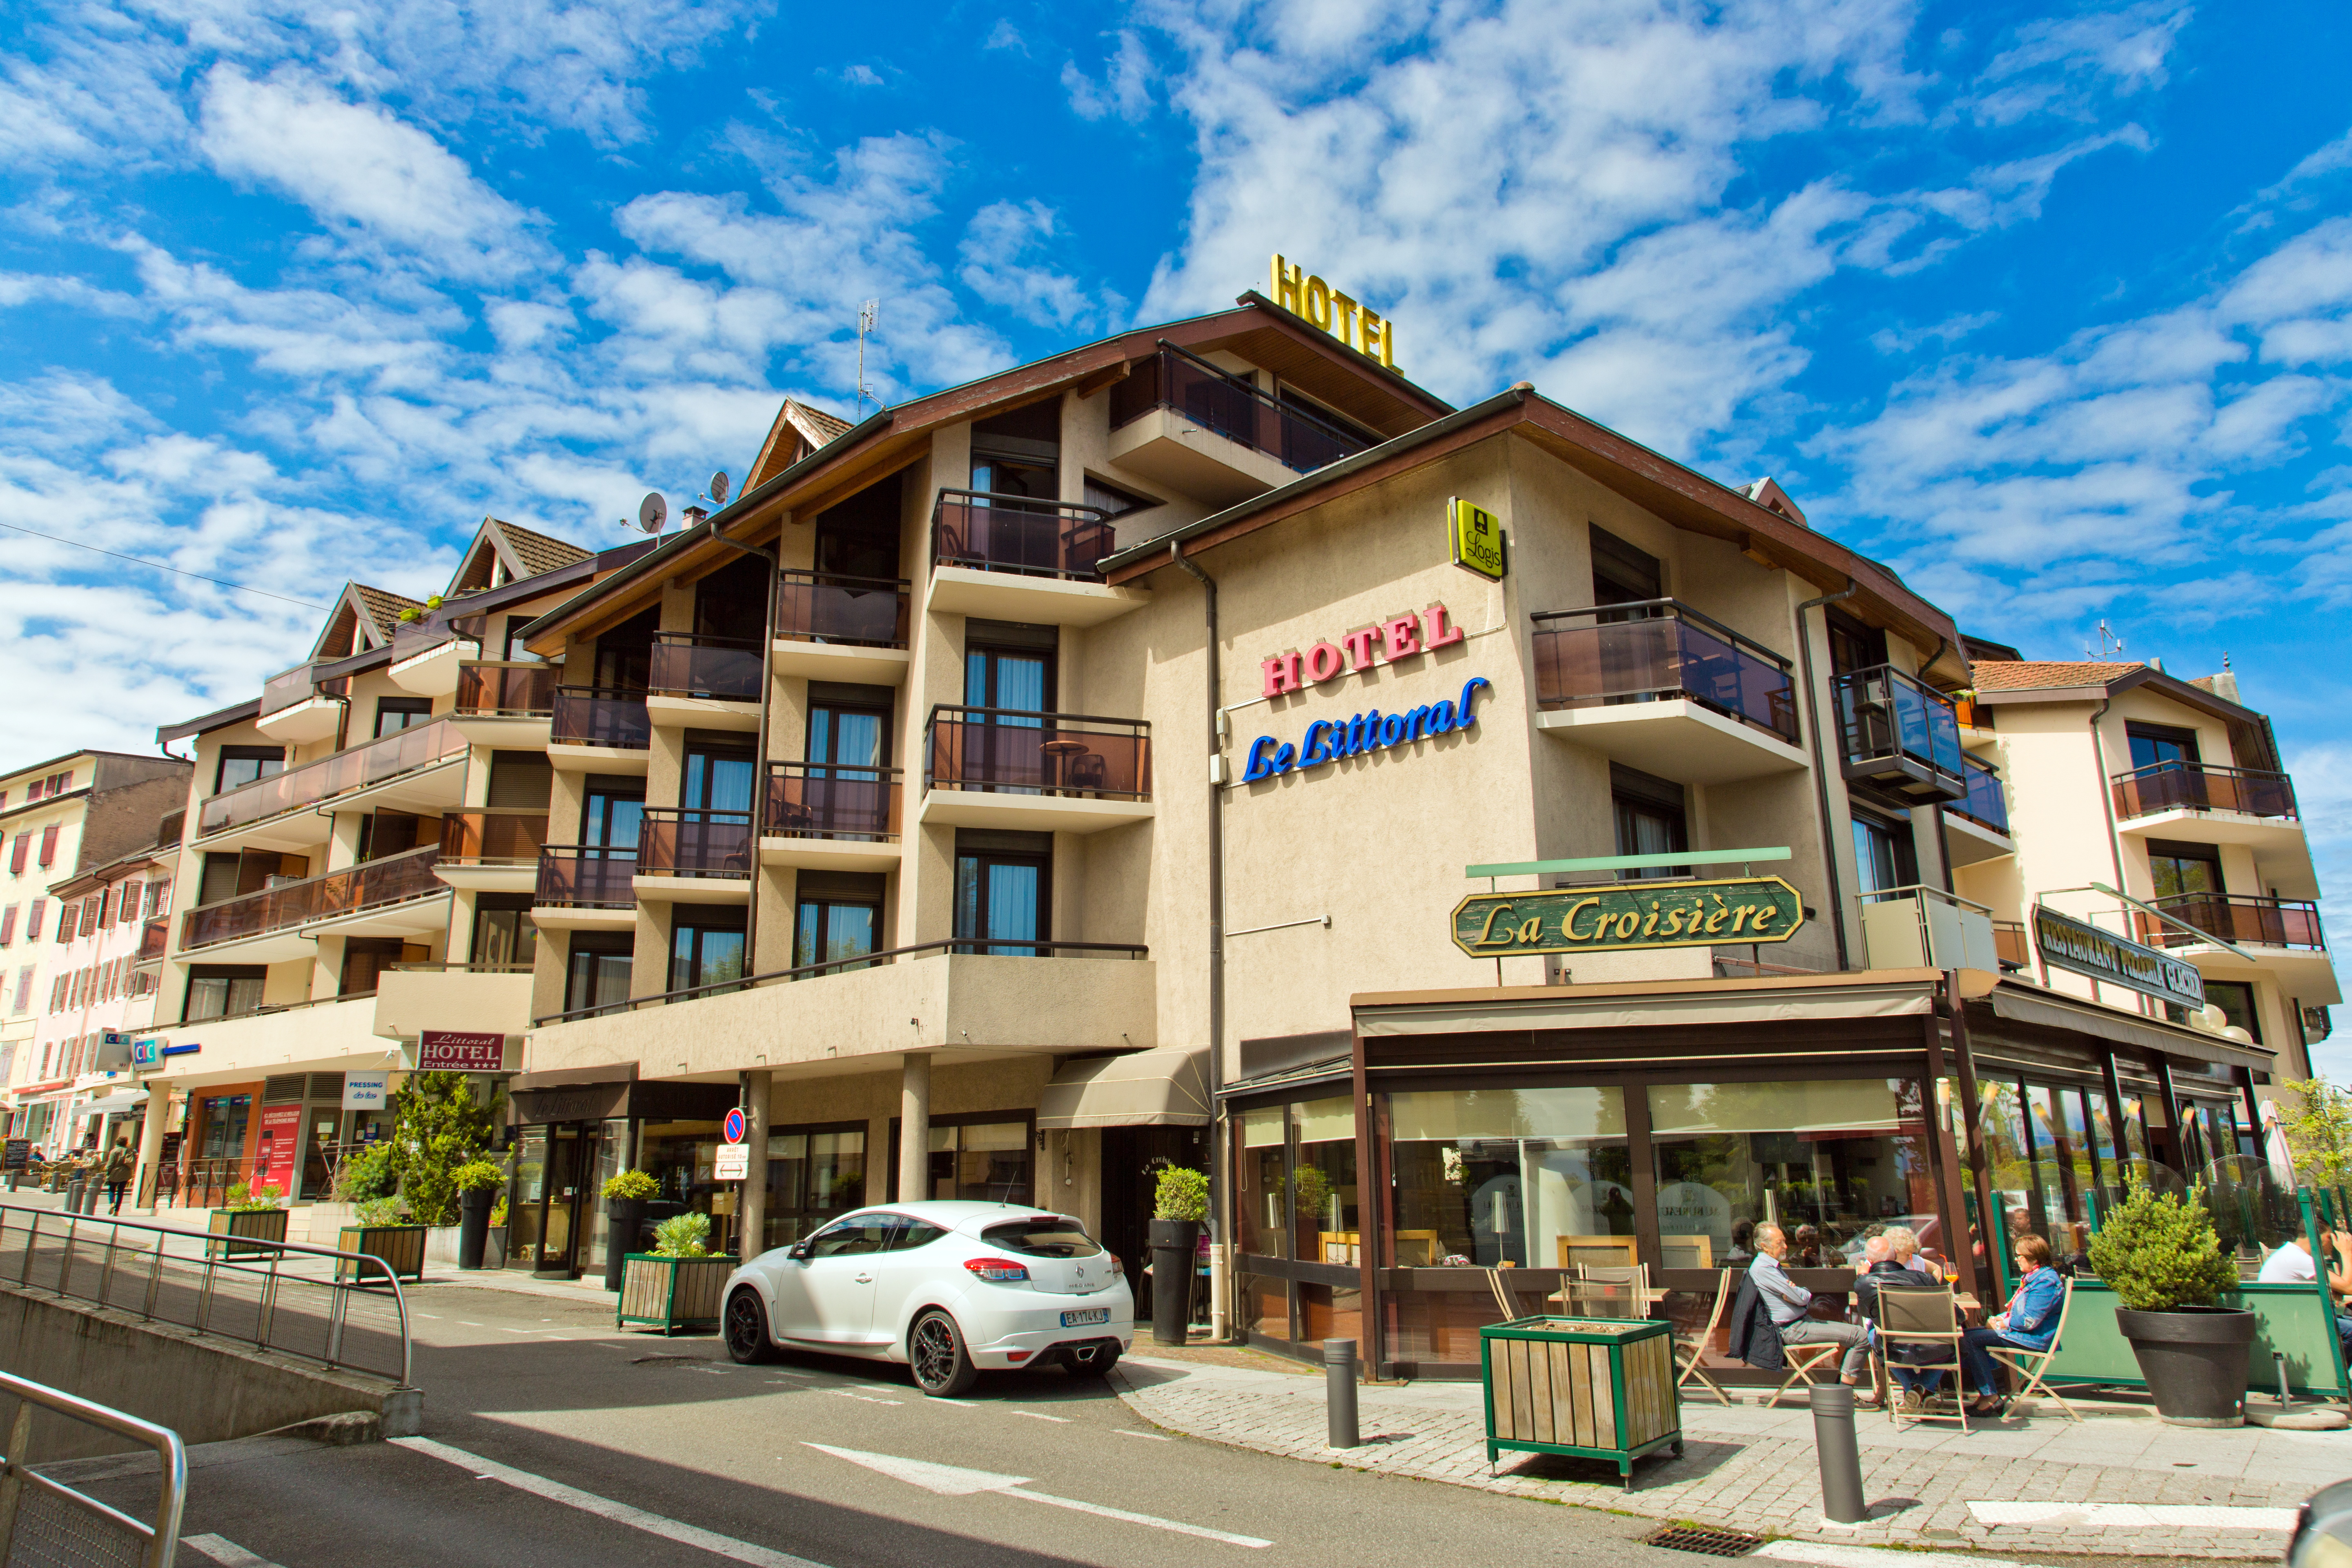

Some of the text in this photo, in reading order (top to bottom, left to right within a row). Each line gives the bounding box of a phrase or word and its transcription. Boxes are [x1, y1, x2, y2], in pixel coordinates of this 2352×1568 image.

[1270, 254, 1404, 378] HOTEL
[1466, 531, 1500, 568] Logis
[1261, 605, 1463, 699] HOTEL
[1242, 677, 1490, 783] Le Littoral
[1474, 893, 1776, 946] La Croisière
[2040, 917, 2203, 1001] RESTAURANT PIZZERIA GLACIER
[108, 1035, 129, 1043] CIC
[135, 1044, 154, 1060] CIC
[423, 1045, 500, 1060] HOTEL
[432, 1034, 495, 1045] Littoral
[535, 1091, 597, 1117] Le Littoral
